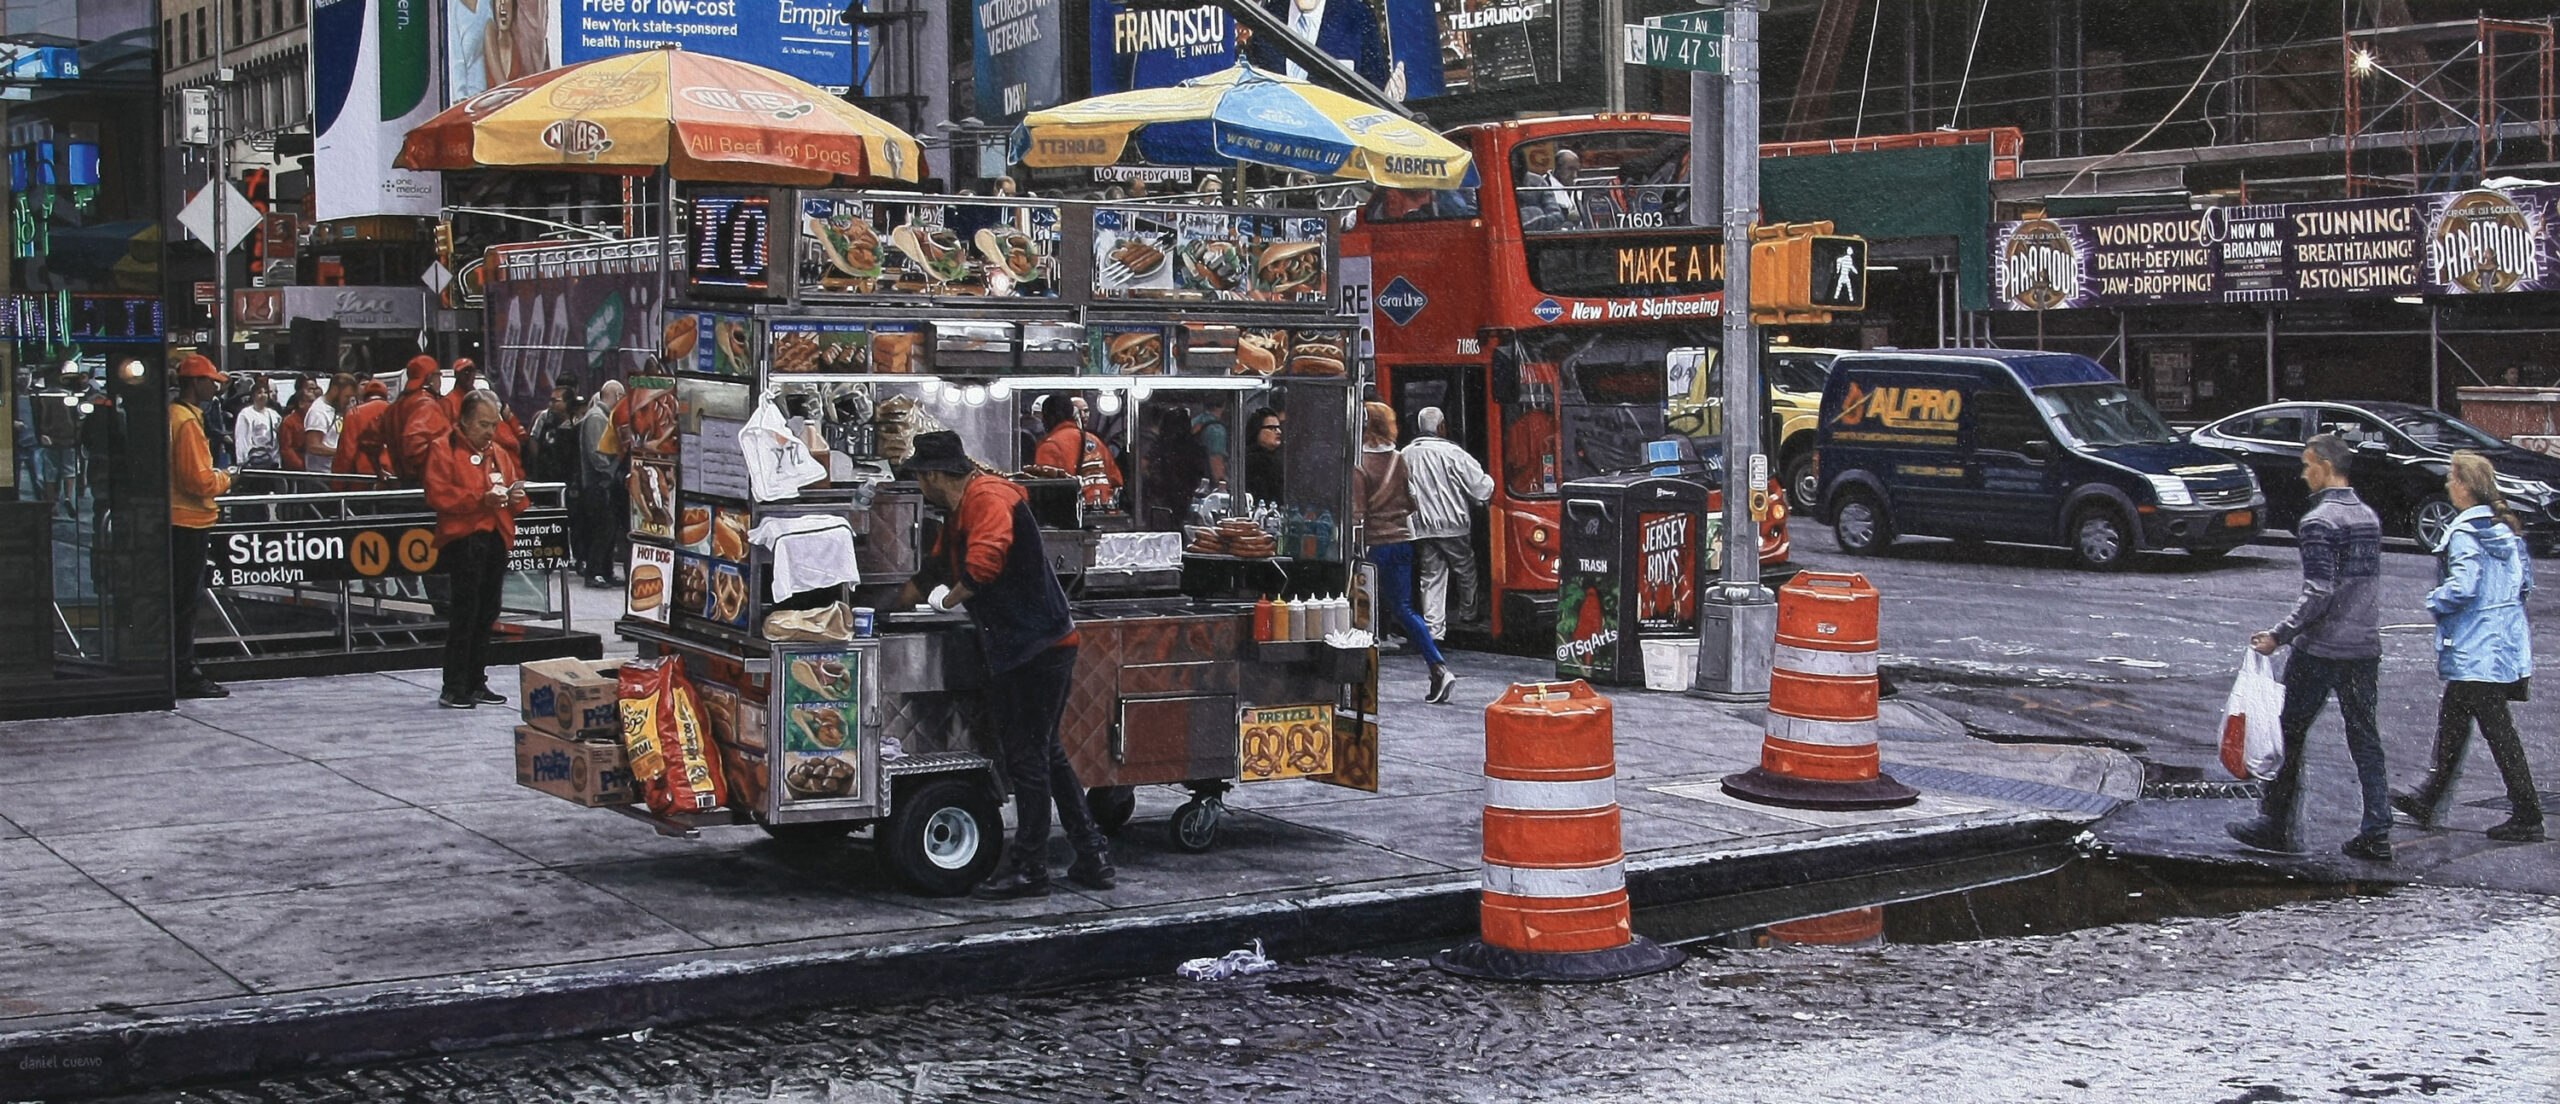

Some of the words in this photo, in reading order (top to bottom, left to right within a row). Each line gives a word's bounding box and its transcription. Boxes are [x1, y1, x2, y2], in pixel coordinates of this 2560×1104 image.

[583, 0, 625, 13] Free
[632, 1, 651, 14] or
[656, 0, 736, 17] low-cost
[979, 0, 1028, 29] VICTORIES
[1449, 6, 1533, 30] TELEMUNDO
[583, 18, 609, 30] New
[611, 18, 640, 32] York
[643, 20, 738, 36] state-sponsored
[987, 14, 1042, 56] VETERANS.
[1115, 5, 1224, 53] FRANCISCO
[1680, 19, 1688, 31] 7
[582, 34, 620, 48] health
[1175, 47, 1188, 59] TE
[1191, 42, 1225, 57] INVITA
[1651, 34, 1669, 61] W
[1678, 38, 1701, 65] 47
[1708, 40, 1721, 58] St
[1003, 82, 1027, 115] DAV
[691, 135, 714, 151] All
[720, 136, 762, 155] Beef
[805, 143, 851, 166] Dogs
[1226, 133, 1261, 149] WE'RE
[1265, 139, 1282, 152] ON
[1283, 143, 1291, 156] A
[1294, 146, 1321, 160] ROLL
[1384, 154, 1449, 177] SABRETT
[395, 184, 432, 194] medical
[396, 178, 413, 186] one
[1617, 211, 1663, 228] 71603
[2231, 223, 2255, 239] NOW
[2260, 222, 2274, 238] ON
[2223, 240, 2283, 259] BROADWAY
[2433, 221, 2539, 285] PARAMOUR
[1619, 246, 1677, 284] MAKE
[1687, 245, 1702, 282] A
[2001, 246, 2079, 302] PARAMOUR
[1572, 302, 1602, 320] New
[1607, 301, 1638, 318] York
[1641, 296, 1720, 319] Sightseeing
[1865, 387, 1962, 421] ALPRO
[514, 525, 550, 535] levator
[551, 523, 562, 534] to
[1642, 518, 1687, 553] JERSEY
[229, 531, 343, 565] Station
[360, 540, 380, 566] N
[408, 539, 428, 564] Q
[637, 547, 654, 559] HOT
[656, 550, 671, 563] DOG
[507, 559, 522, 570] 49
[523, 559, 535, 570] St
[537, 559, 545, 569] &
[546, 558, 553, 568] 7
[556, 557, 569, 568] Av
[1579, 558, 1608, 573] TRASH
[1647, 549, 1679, 585] BOYS
[212, 569, 225, 586] &
[231, 566, 304, 585] Brooklyn
[1556, 628, 1618, 662] @TSqArts
[1257, 707, 1314, 724] PRETZEL
[19, 1055, 58, 1071] daniel
